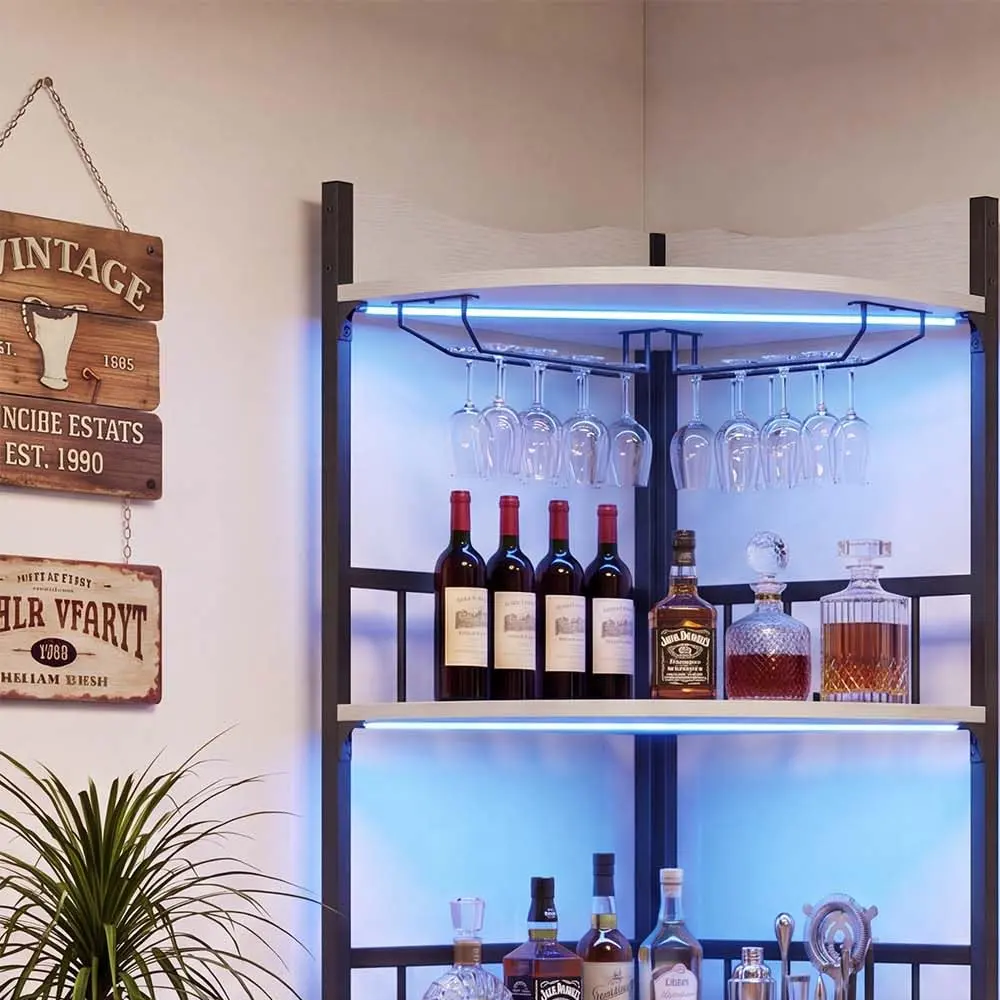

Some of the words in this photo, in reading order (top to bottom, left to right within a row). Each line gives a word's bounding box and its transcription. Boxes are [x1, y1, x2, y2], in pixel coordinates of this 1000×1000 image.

[68, 414, 144, 444] ESTATS
[5, 442, 49, 468] EST.
[57, 447, 104, 474] 1990
[55, 598, 147, 661] VFARYT
